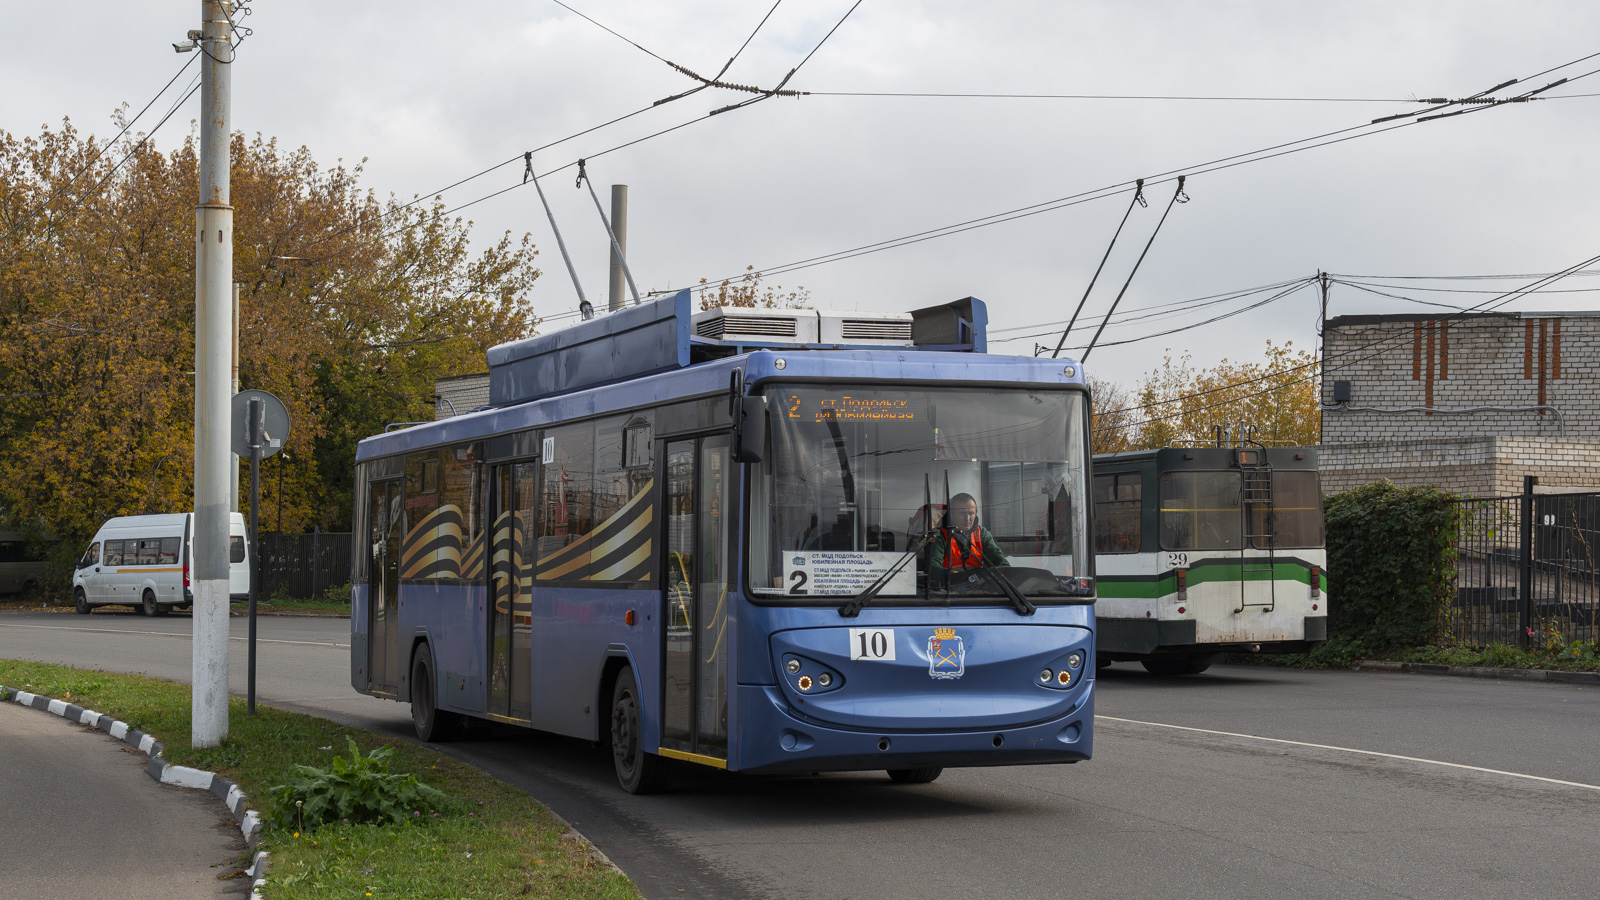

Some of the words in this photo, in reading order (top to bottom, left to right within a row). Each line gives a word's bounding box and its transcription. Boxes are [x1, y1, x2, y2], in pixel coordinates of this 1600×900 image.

[789, 395, 800, 417] 2
[545, 440, 552, 462] 10
[1242, 452, 1247, 462] 1
[1168, 552, 1188, 566] 29
[789, 570, 808, 594] 2
[858, 631, 888, 657] 10
